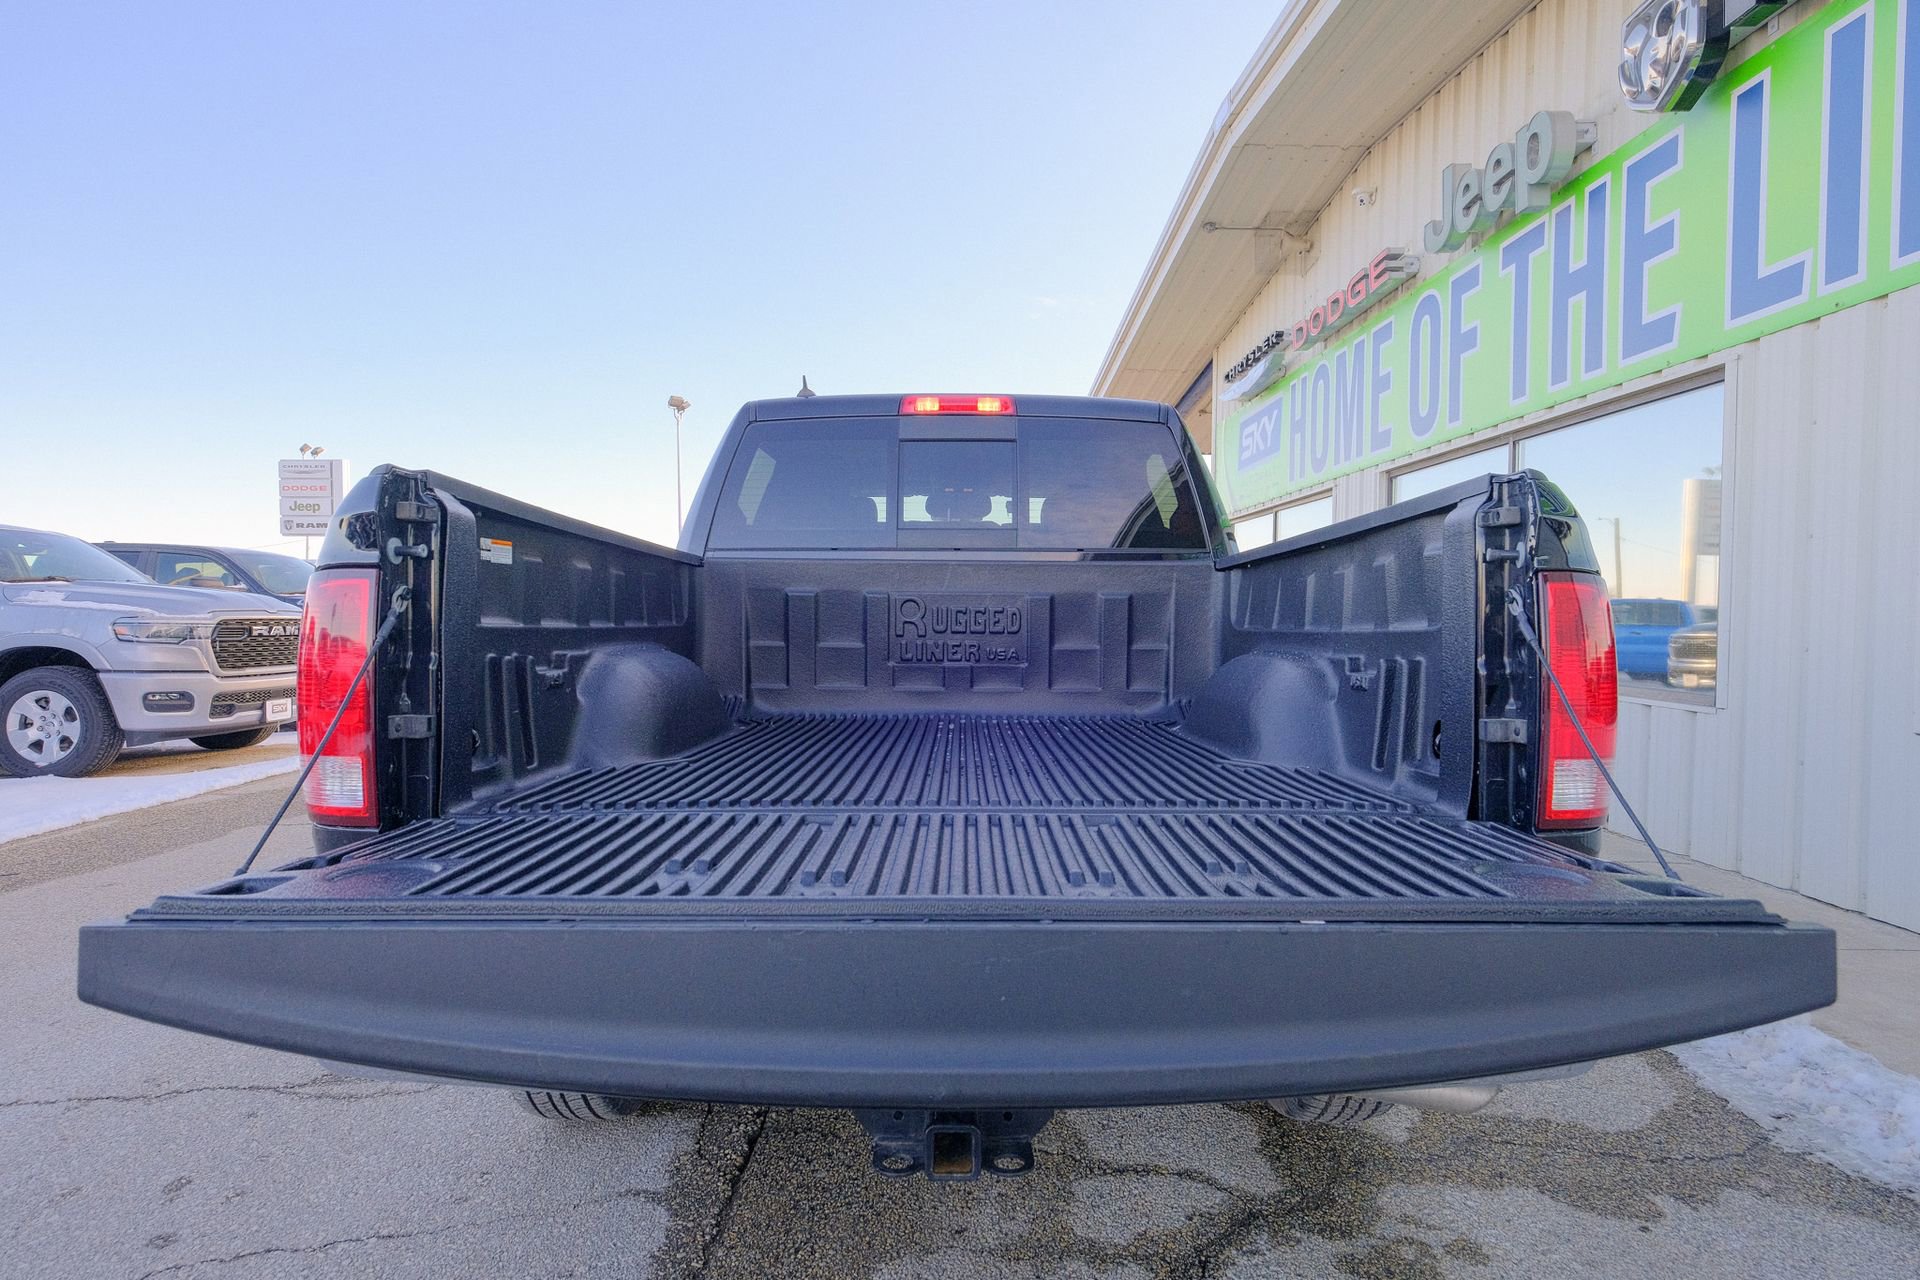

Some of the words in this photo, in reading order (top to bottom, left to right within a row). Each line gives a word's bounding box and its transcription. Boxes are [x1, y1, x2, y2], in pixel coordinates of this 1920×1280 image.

[1424, 111, 1560, 254] Jeep
[1240, 408, 1278, 462] SKY
[1288, 316, 1394, 484] HOME
[1408, 256, 1483, 442] OF
[1499, 124, 1684, 406] THE
[1292, 248, 1392, 351] DODGE
[289, 501, 321, 514] Jeep
[252, 625, 299, 636] RAM
[894, 596, 1022, 638] RUGGED
[899, 640, 981, 663] LINER
[986, 648, 1020, 661] USA
